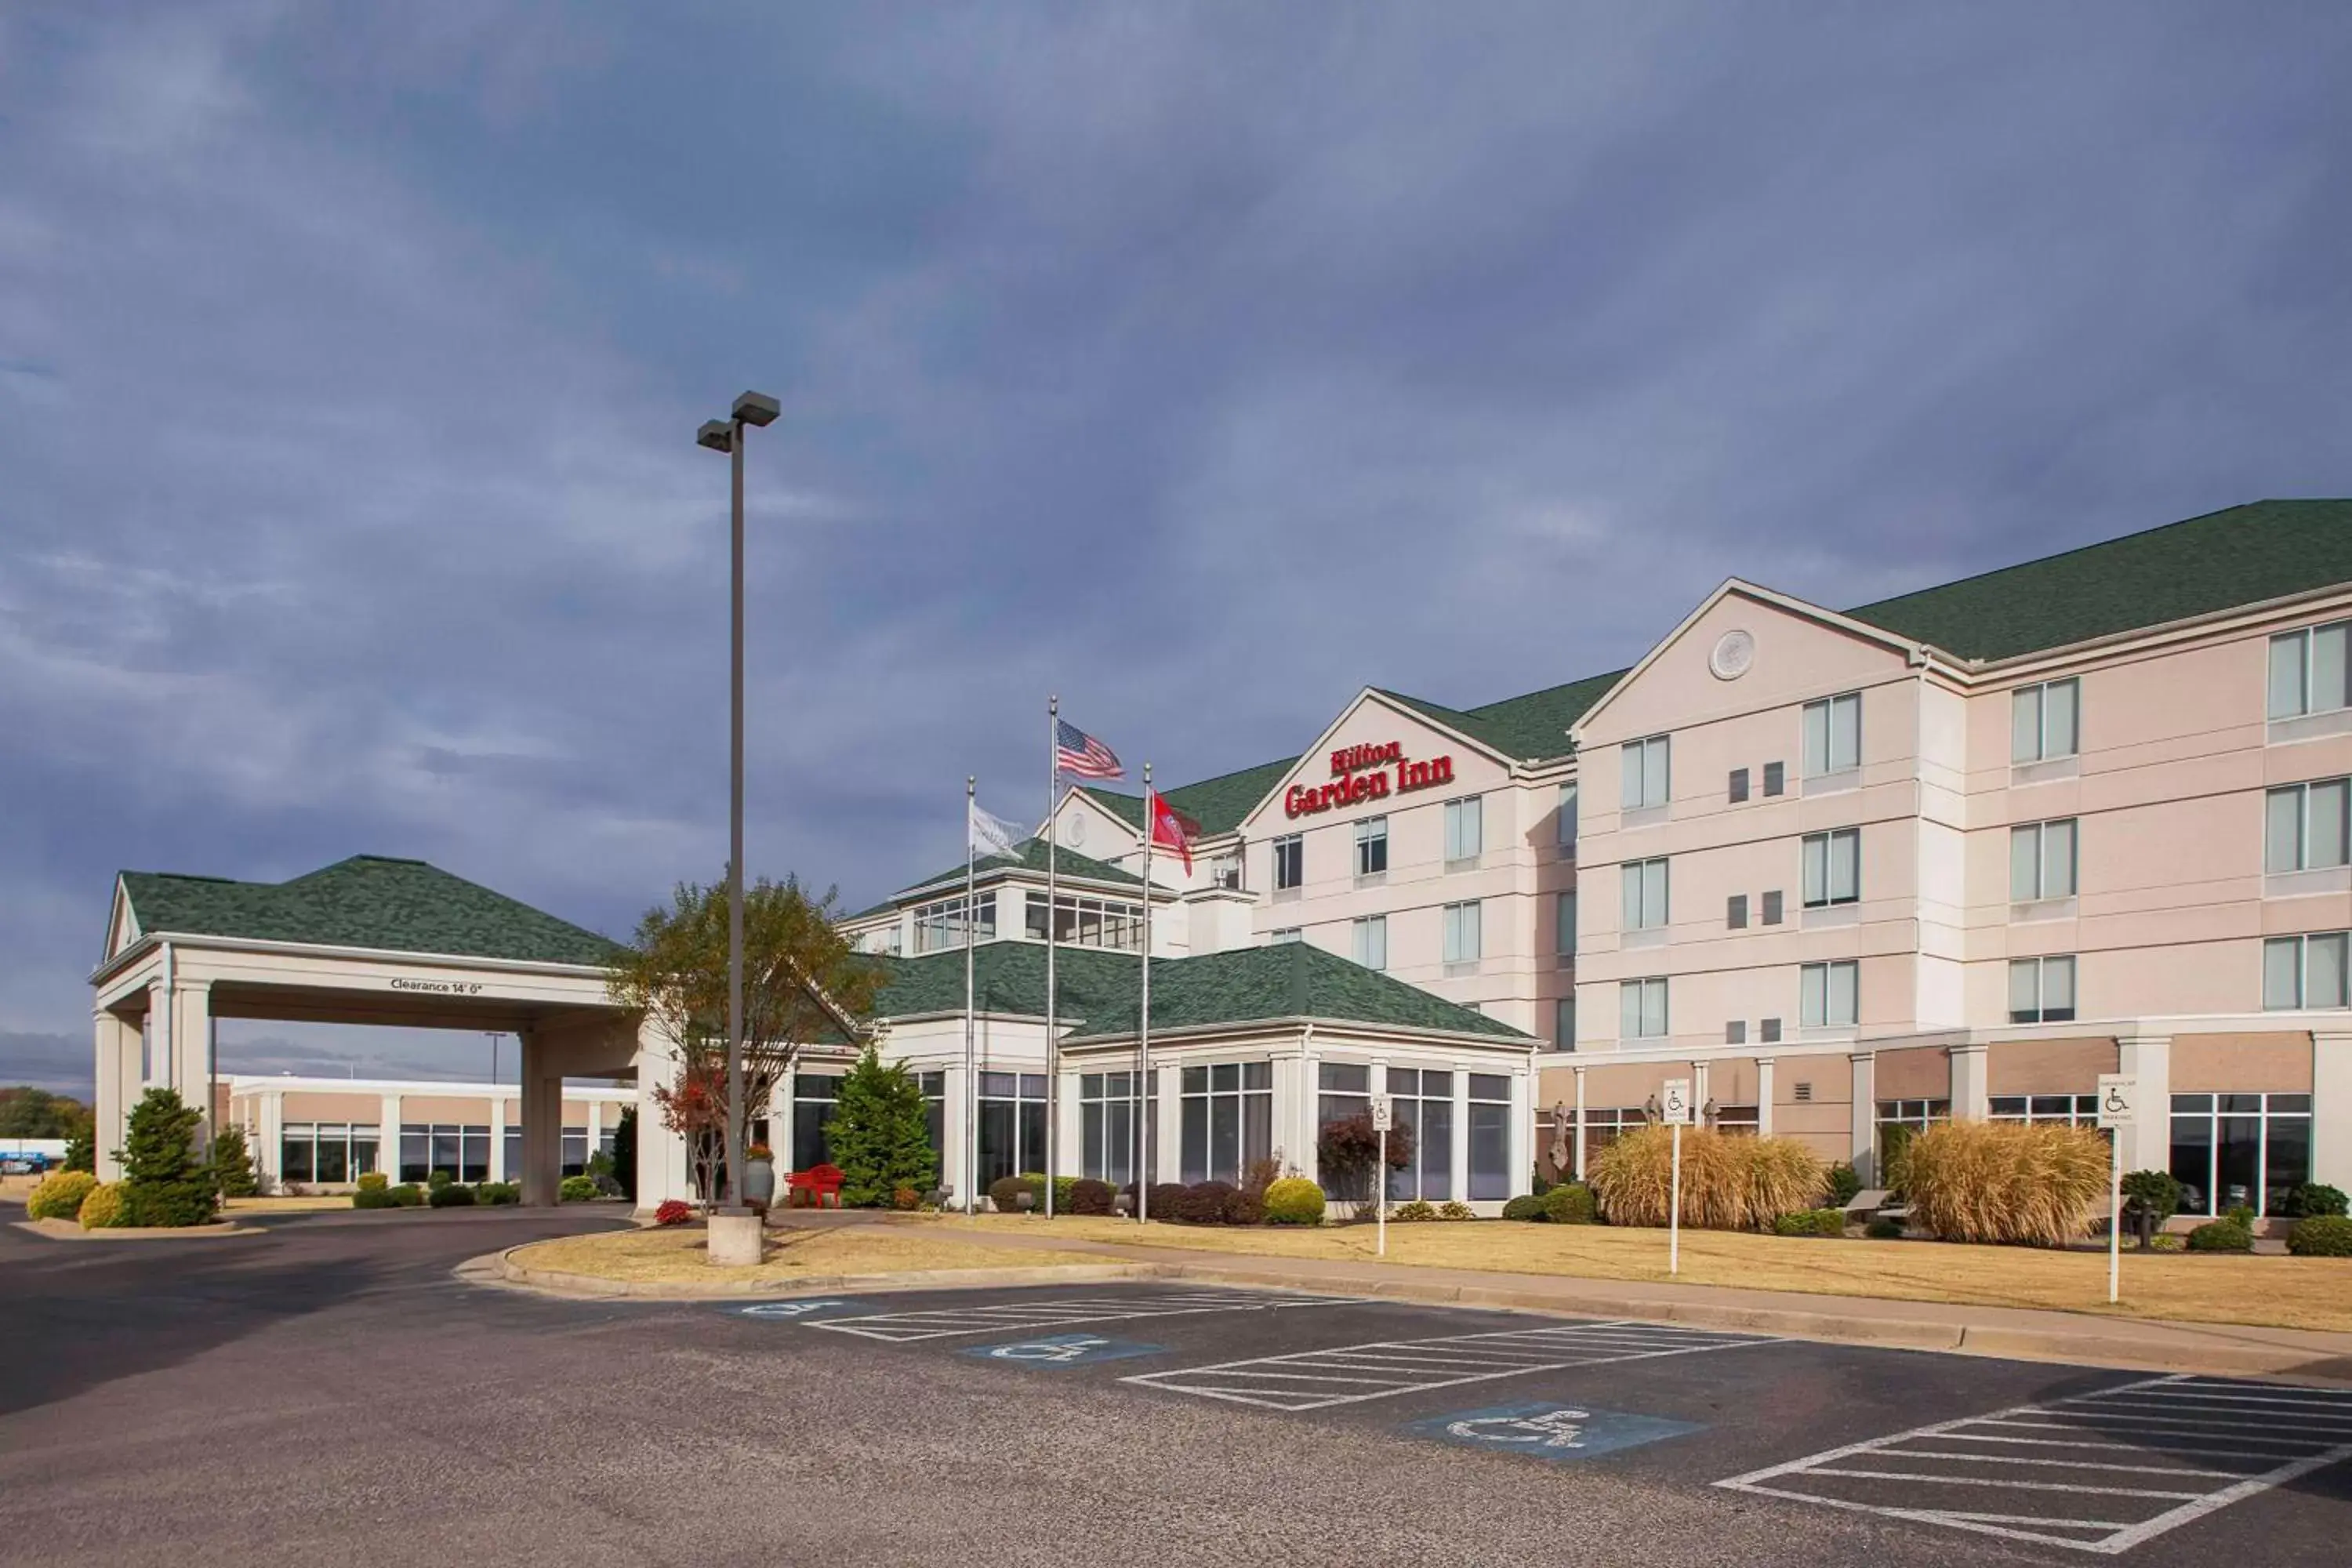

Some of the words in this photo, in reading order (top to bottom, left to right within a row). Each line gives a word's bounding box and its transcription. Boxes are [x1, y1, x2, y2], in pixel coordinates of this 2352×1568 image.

[1330, 740, 1403, 773] Hilton
[1284, 769, 1390, 820] Garden
[1396, 755, 1454, 792] Inn
[390, 978, 449, 992] Clearance
